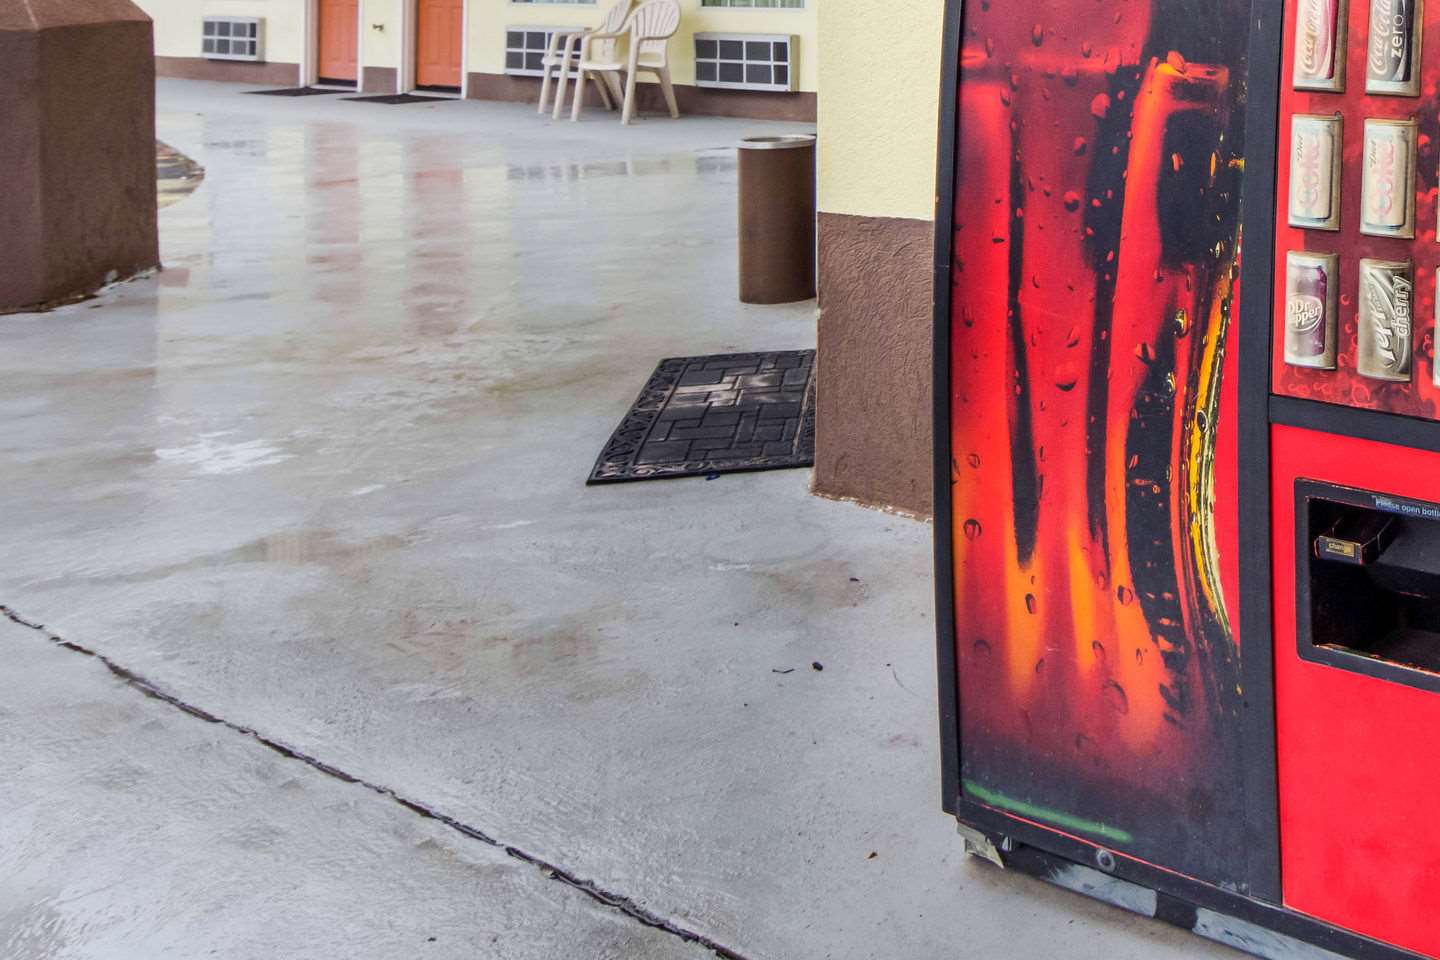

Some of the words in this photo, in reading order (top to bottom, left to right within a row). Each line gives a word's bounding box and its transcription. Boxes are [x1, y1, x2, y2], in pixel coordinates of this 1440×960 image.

[1391, 14, 1405, 58] zero
[1391, 275, 1412, 337] cherry
[1401, 504, 1420, 514] open
